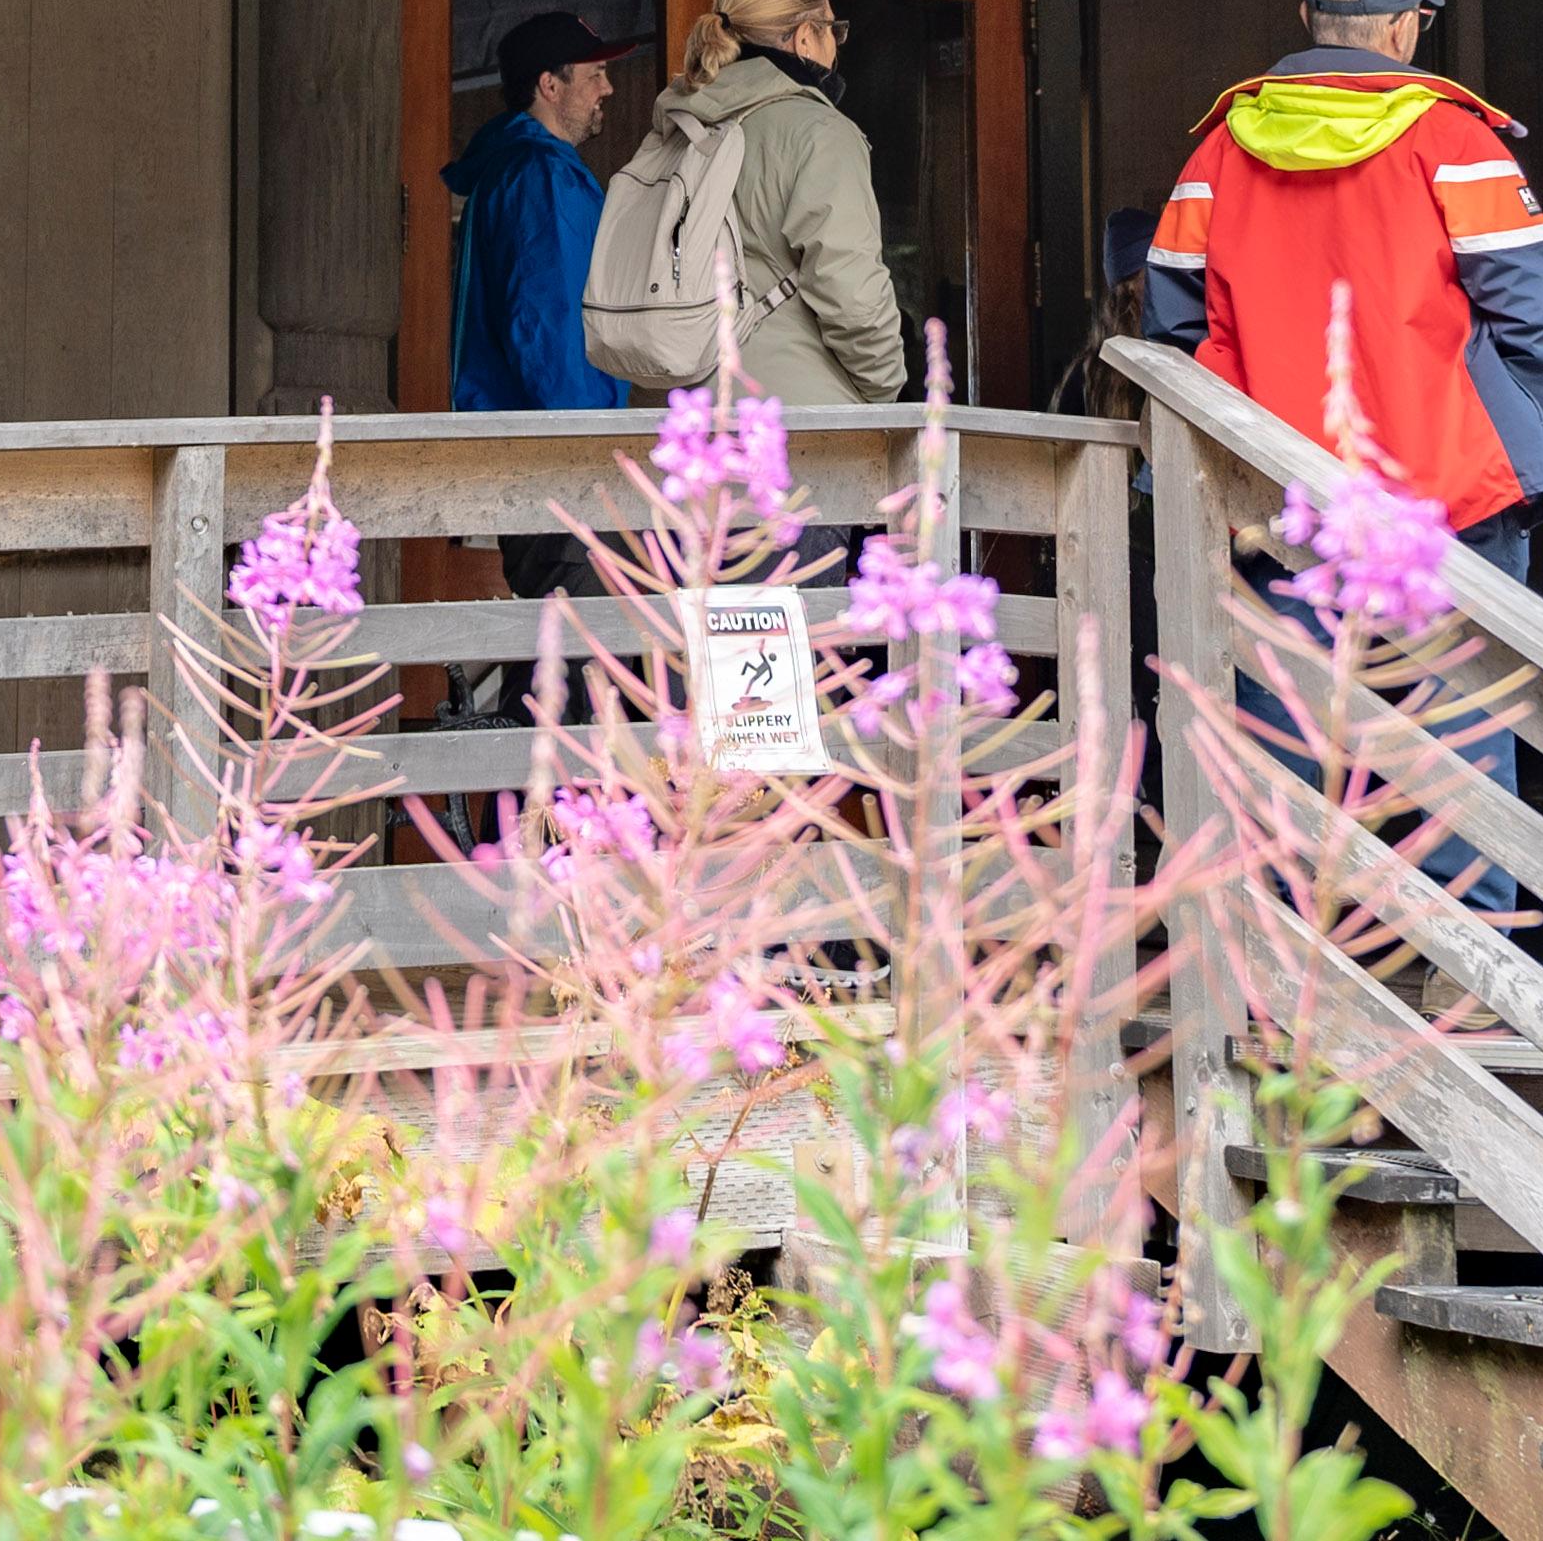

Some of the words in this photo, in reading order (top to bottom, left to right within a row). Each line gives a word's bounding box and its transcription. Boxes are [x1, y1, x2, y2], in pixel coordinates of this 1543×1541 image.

[707, 611, 786, 633] CAUTION
[726, 714, 792, 728] SLIPPERY
[723, 731, 766, 744] WHEN
[770, 731, 799, 744] WET
